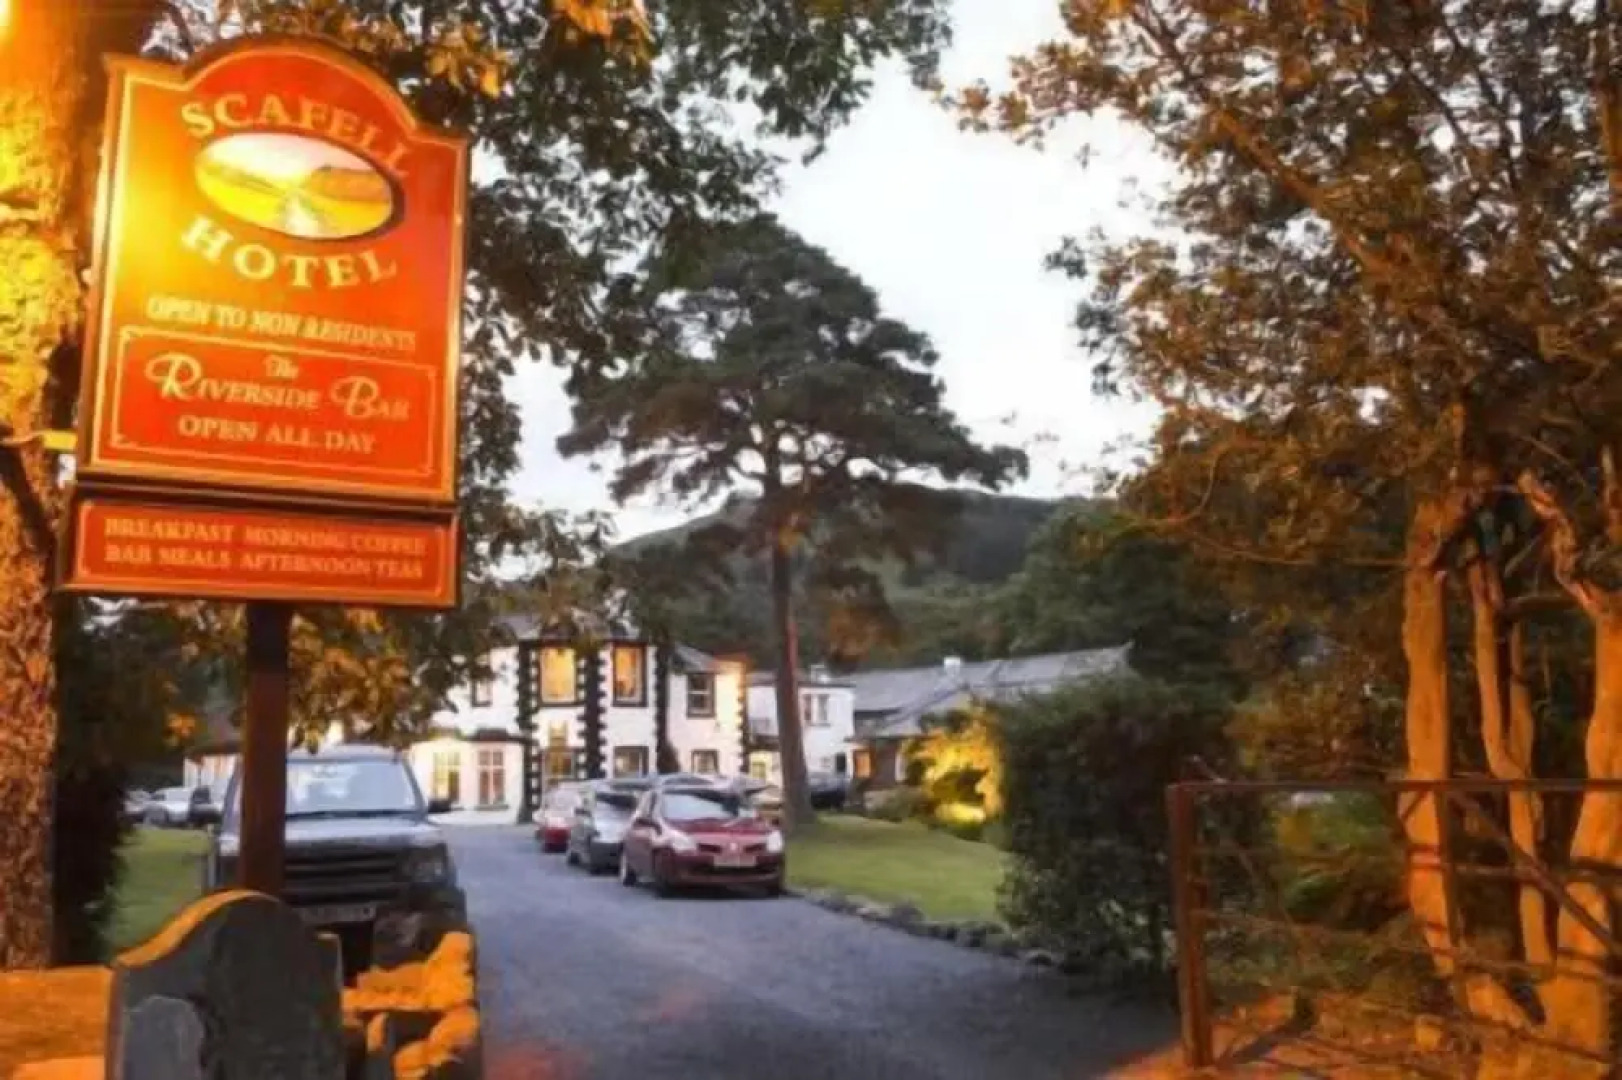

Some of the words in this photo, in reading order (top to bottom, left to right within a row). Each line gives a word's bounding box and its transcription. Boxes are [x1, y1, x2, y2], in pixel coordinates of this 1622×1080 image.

[181, 94, 411, 176] SCAFELL
[182, 216, 397, 288] HOTEL
[147, 298, 210, 324] OPEN
[217, 305, 246, 327] TO
[250, 310, 300, 335] NON
[304, 316, 415, 350] RESIDENTS
[264, 356, 298, 379] The
[179, 415, 258, 442] OPEN
[266, 423, 315, 447] ALL
[325, 430, 376, 453] DAY
[105, 518, 233, 541] BREAKFAST
[246, 527, 344, 549] MORNING
[352, 534, 426, 554] COFFEE
[105, 544, 151, 563] BAR
[159, 548, 230, 568] MEALS
[241, 555, 370, 576] AFTERNOON
[375, 560, 423, 578] TEAS
